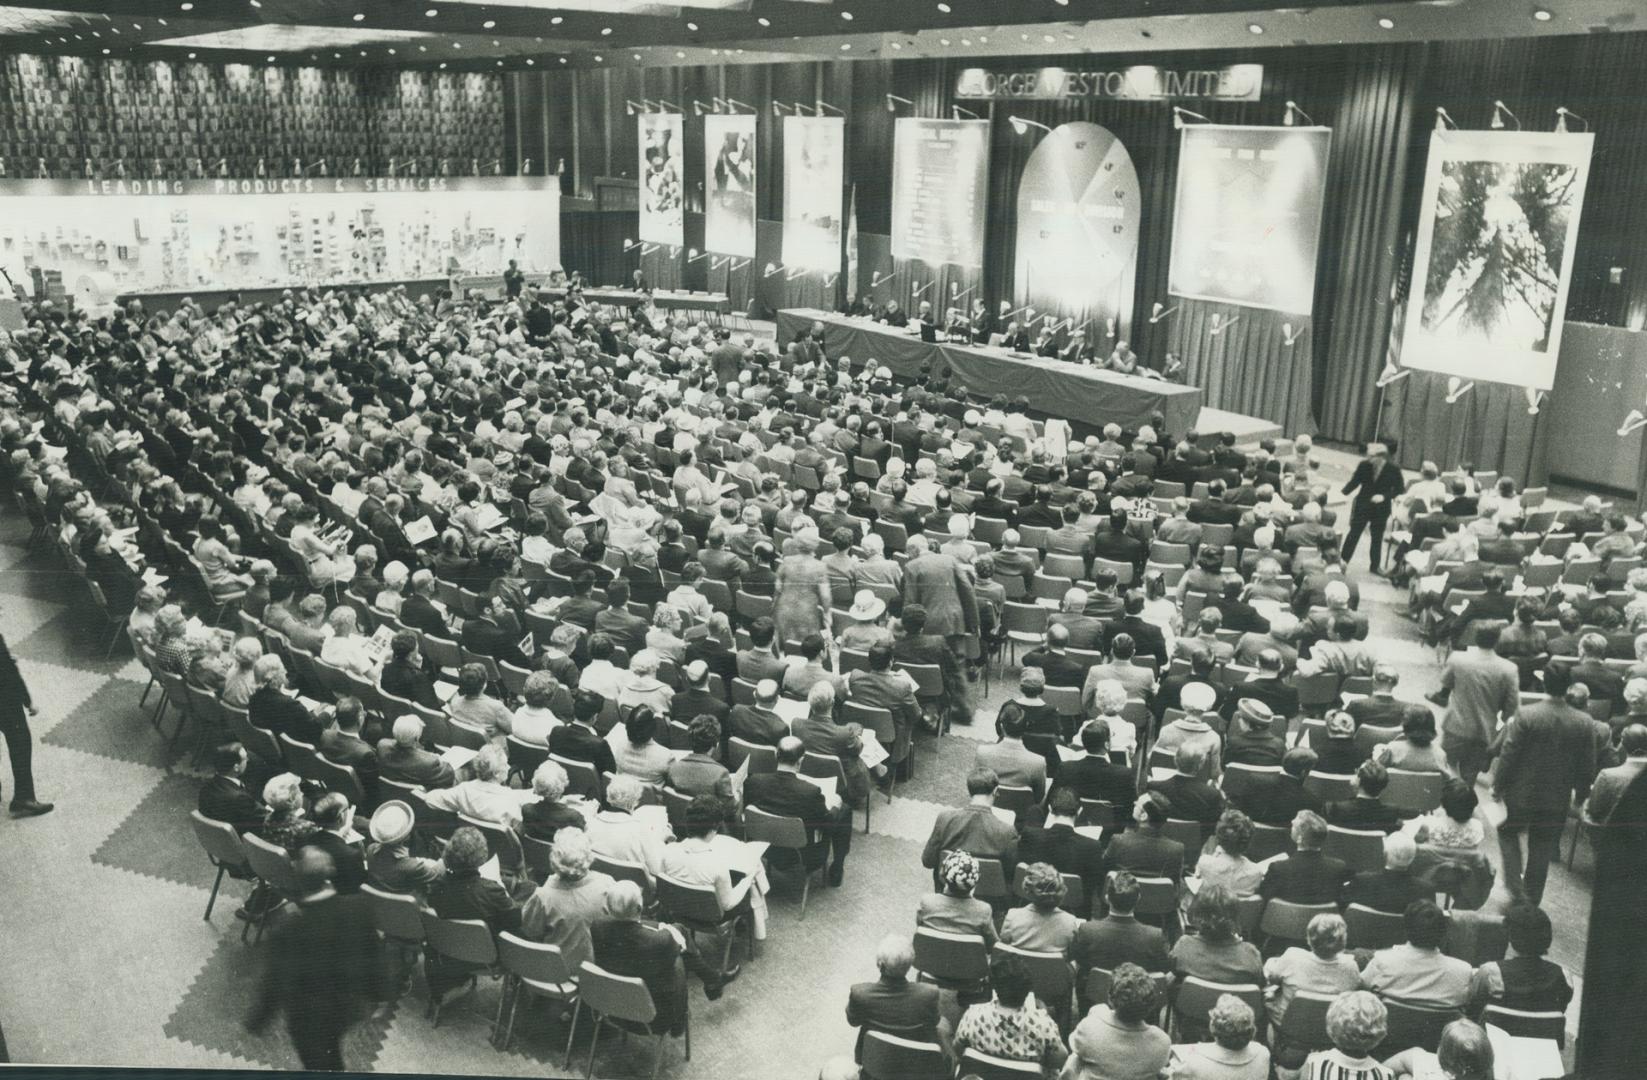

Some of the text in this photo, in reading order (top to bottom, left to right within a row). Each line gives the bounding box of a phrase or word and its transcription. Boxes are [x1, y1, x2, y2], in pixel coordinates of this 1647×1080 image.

[88, 178, 447, 195] LEADING PRODUCTS & SERVICES
